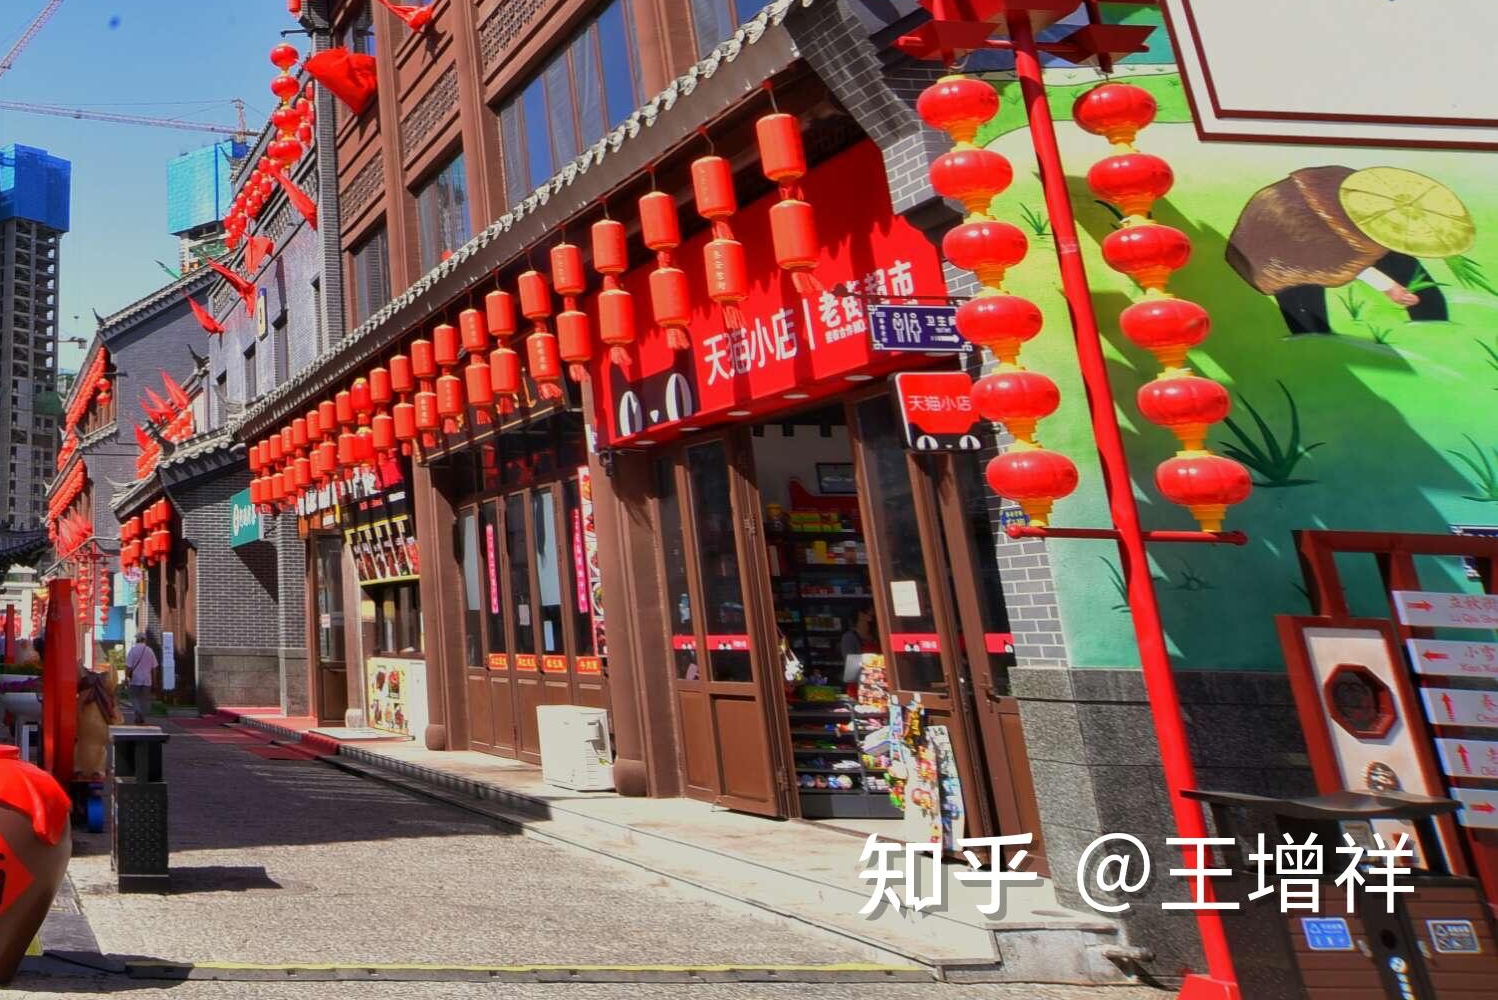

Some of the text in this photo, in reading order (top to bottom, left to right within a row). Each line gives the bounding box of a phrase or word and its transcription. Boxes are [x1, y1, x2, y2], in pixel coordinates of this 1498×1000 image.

[703, 307, 798, 387] 天猫小店
[908, 395, 972, 412] 天猫小店
